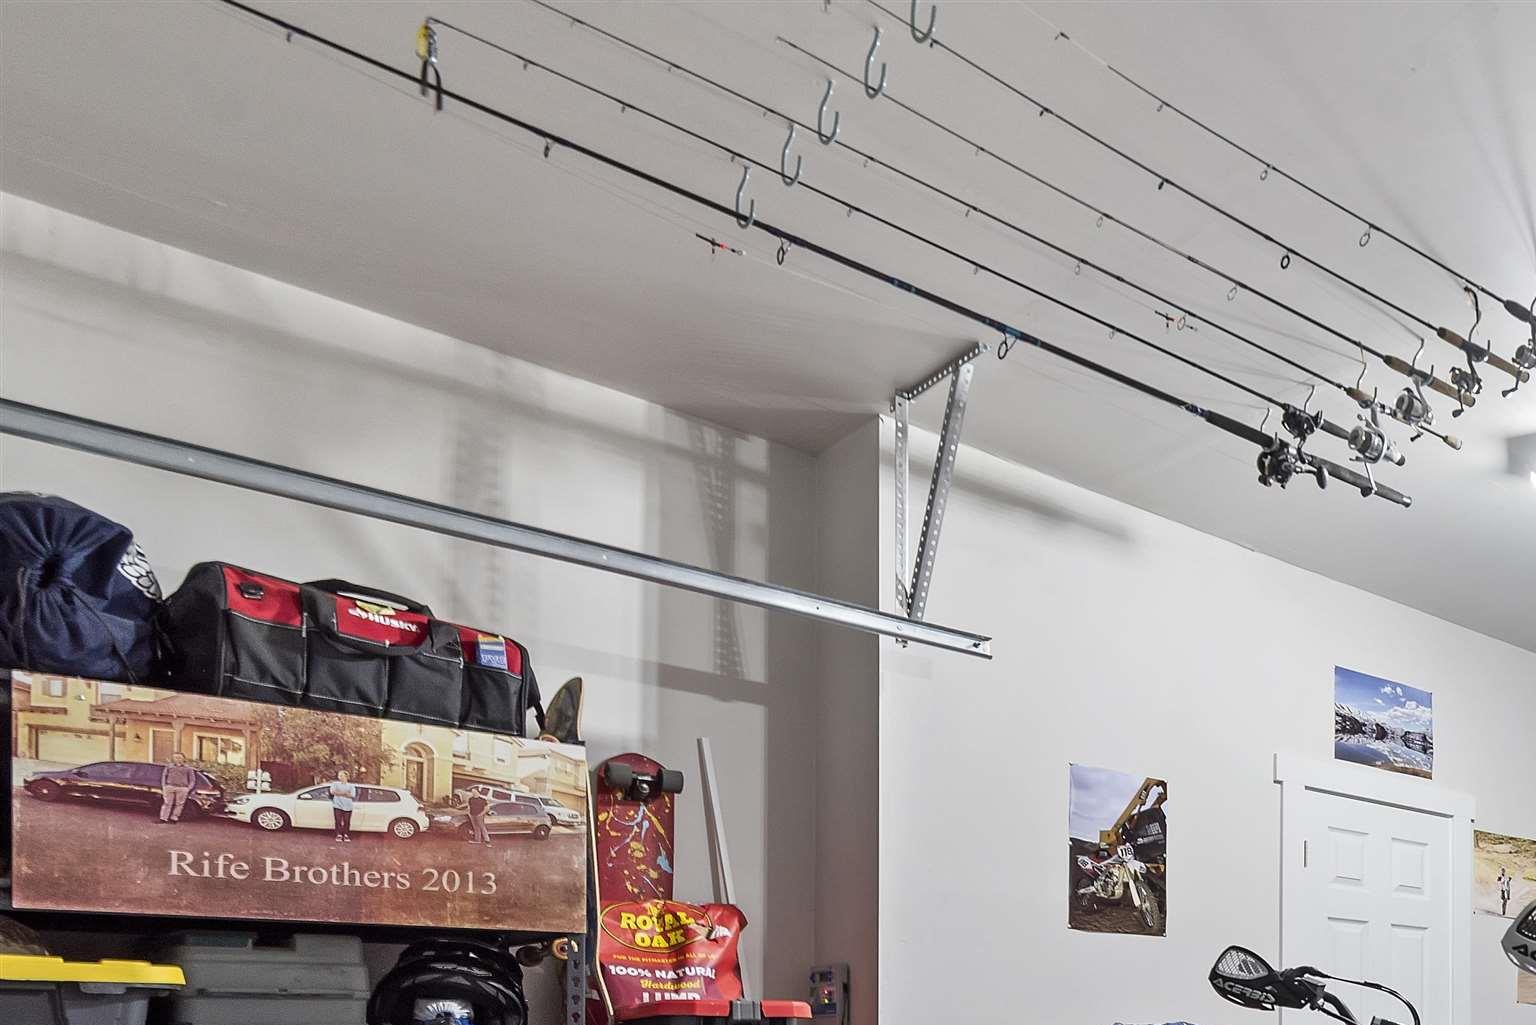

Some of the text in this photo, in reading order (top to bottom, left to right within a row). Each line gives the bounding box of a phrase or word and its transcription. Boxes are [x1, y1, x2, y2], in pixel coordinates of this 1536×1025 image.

[368, 613, 419, 633] HUSKY
[168, 850, 498, 895] Rife Brothers 2013
[620, 911, 695, 933] ROYAL
[634, 930, 687, 948] OAK
[609, 964, 652, 978] 100%
[640, 978, 701, 991] Hardwood
